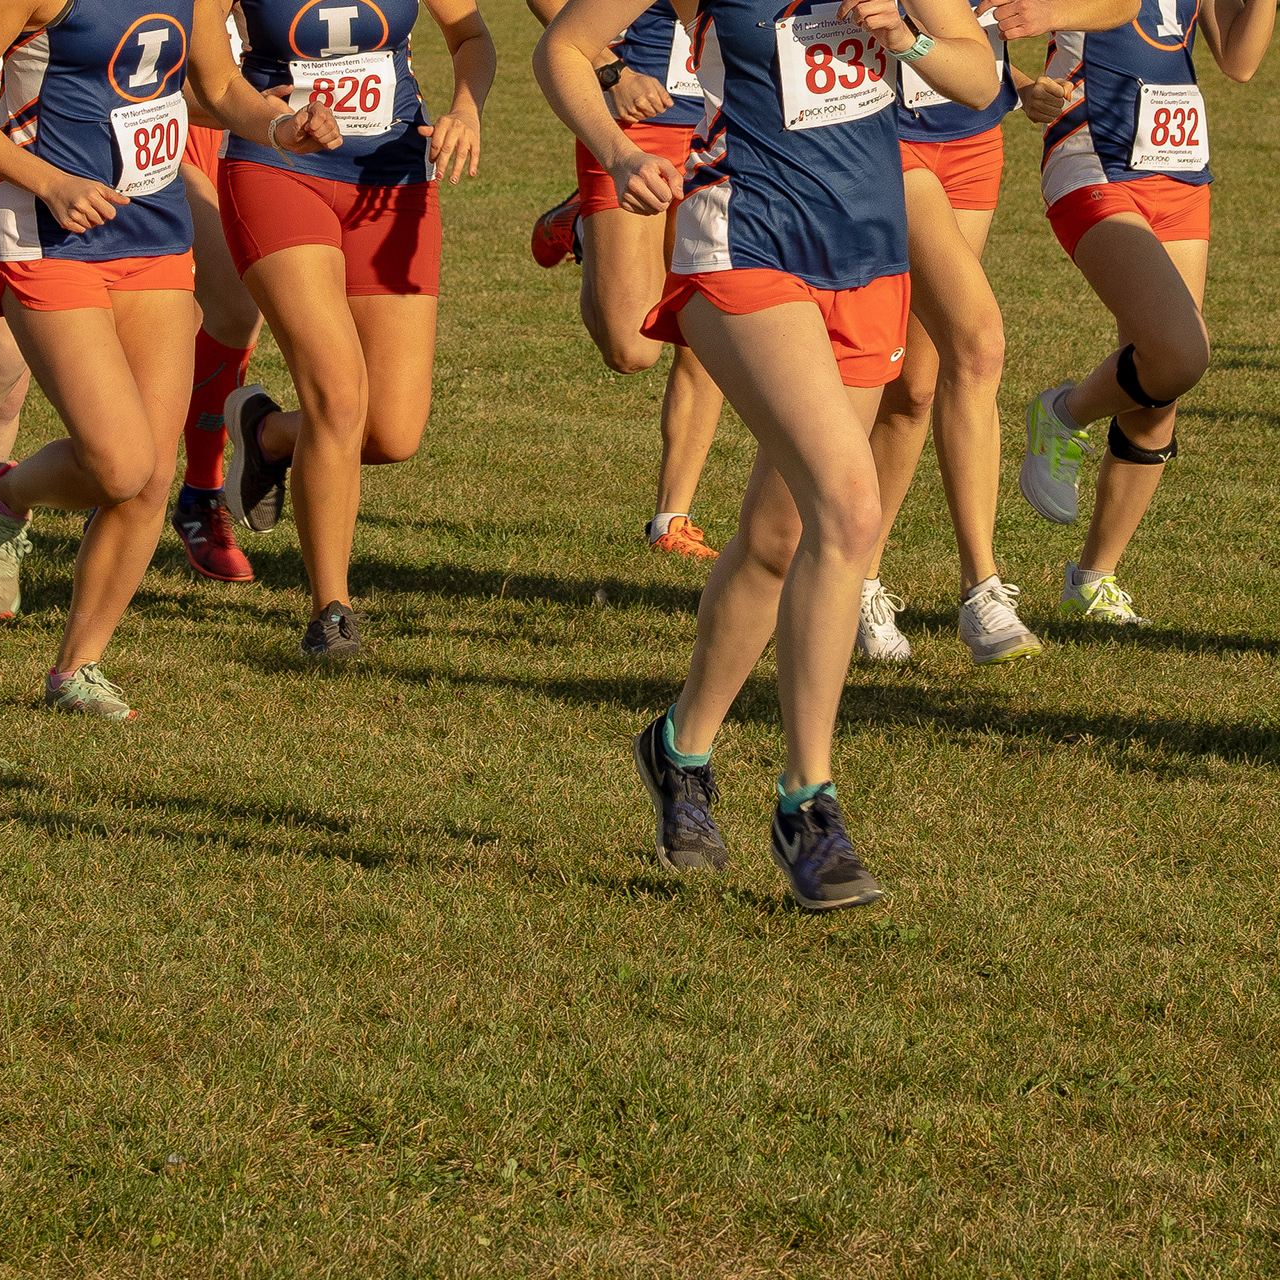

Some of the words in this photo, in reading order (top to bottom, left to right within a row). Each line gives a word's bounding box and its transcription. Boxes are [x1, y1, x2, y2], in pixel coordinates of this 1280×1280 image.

[318, 6, 359, 58] I
[815, 28, 846, 40] Country
[128, 28, 169, 88] I
[311, 59, 360, 69] Northwestern
[805, 35, 887, 95] 833
[309, 74, 382, 113] 826
[805, 107, 822, 118] DICK
[823, 103, 847, 115] POND
[133, 118, 179, 171] 820
[1150, 107, 1199, 147] 832
